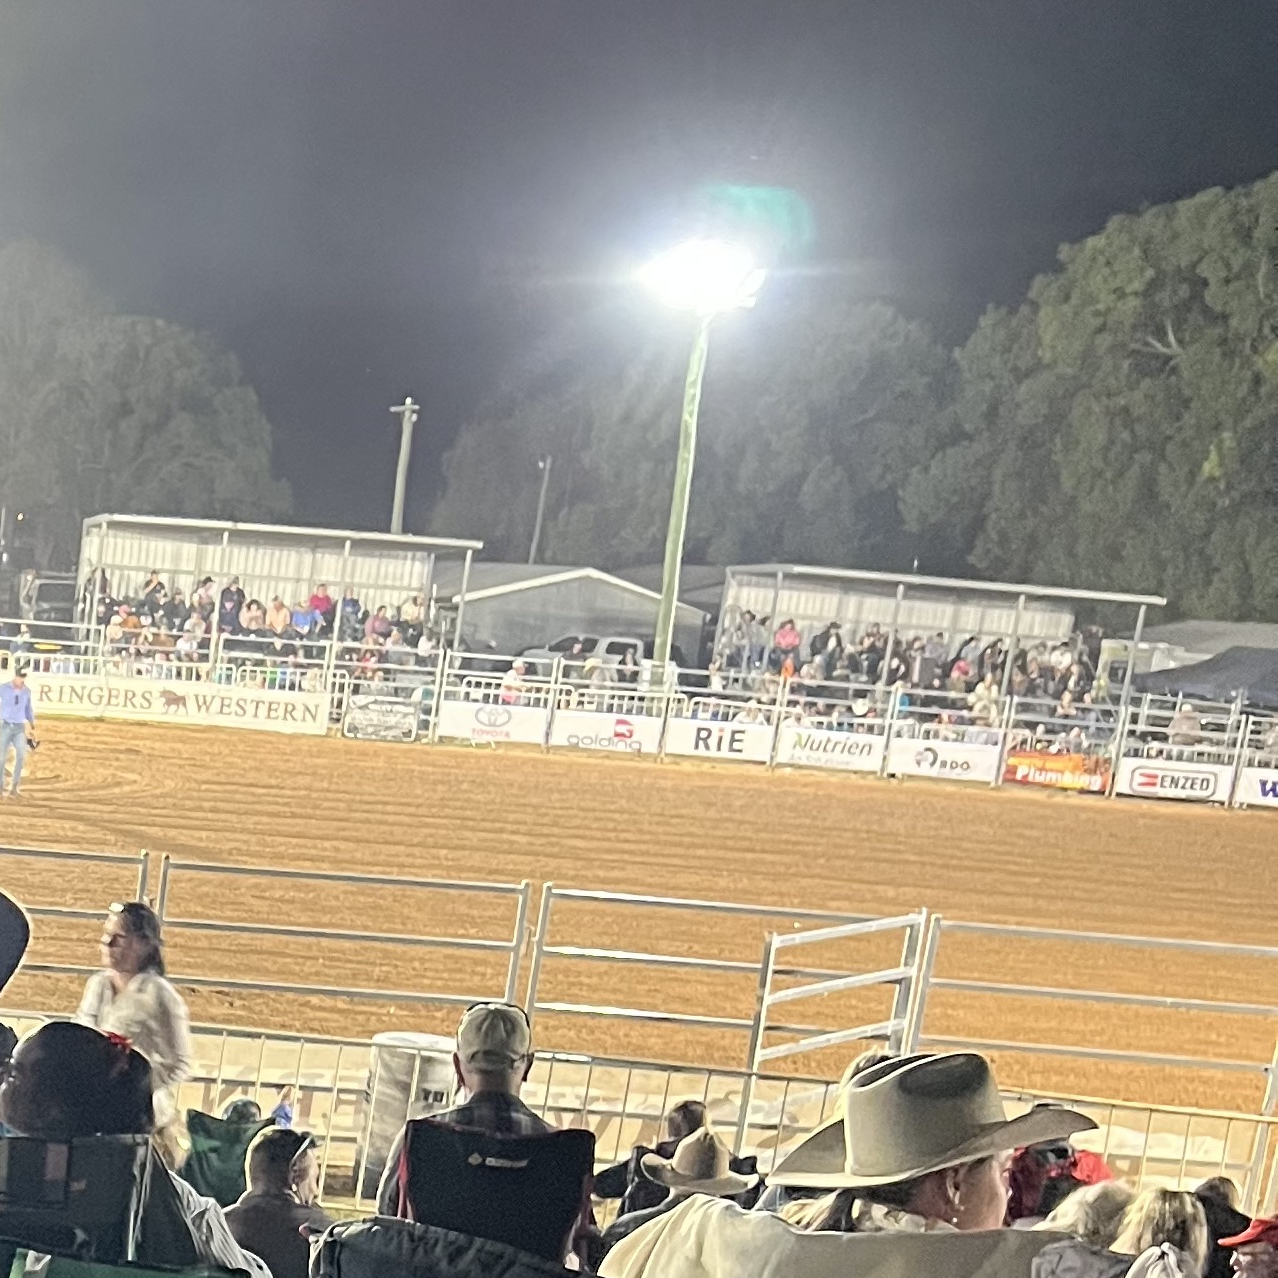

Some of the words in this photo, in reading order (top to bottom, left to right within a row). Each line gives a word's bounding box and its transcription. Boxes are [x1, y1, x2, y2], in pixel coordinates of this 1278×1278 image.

[38, 684, 153, 710] RINGERS
[194, 695, 320, 723] WESTERN
[472, 727, 510, 739] TOYOTA
[567, 733, 642, 758] golding
[694, 727, 746, 753] RiE
[791, 731, 874, 757] Nutrien
[1160, 774, 1210, 791] ENZED
